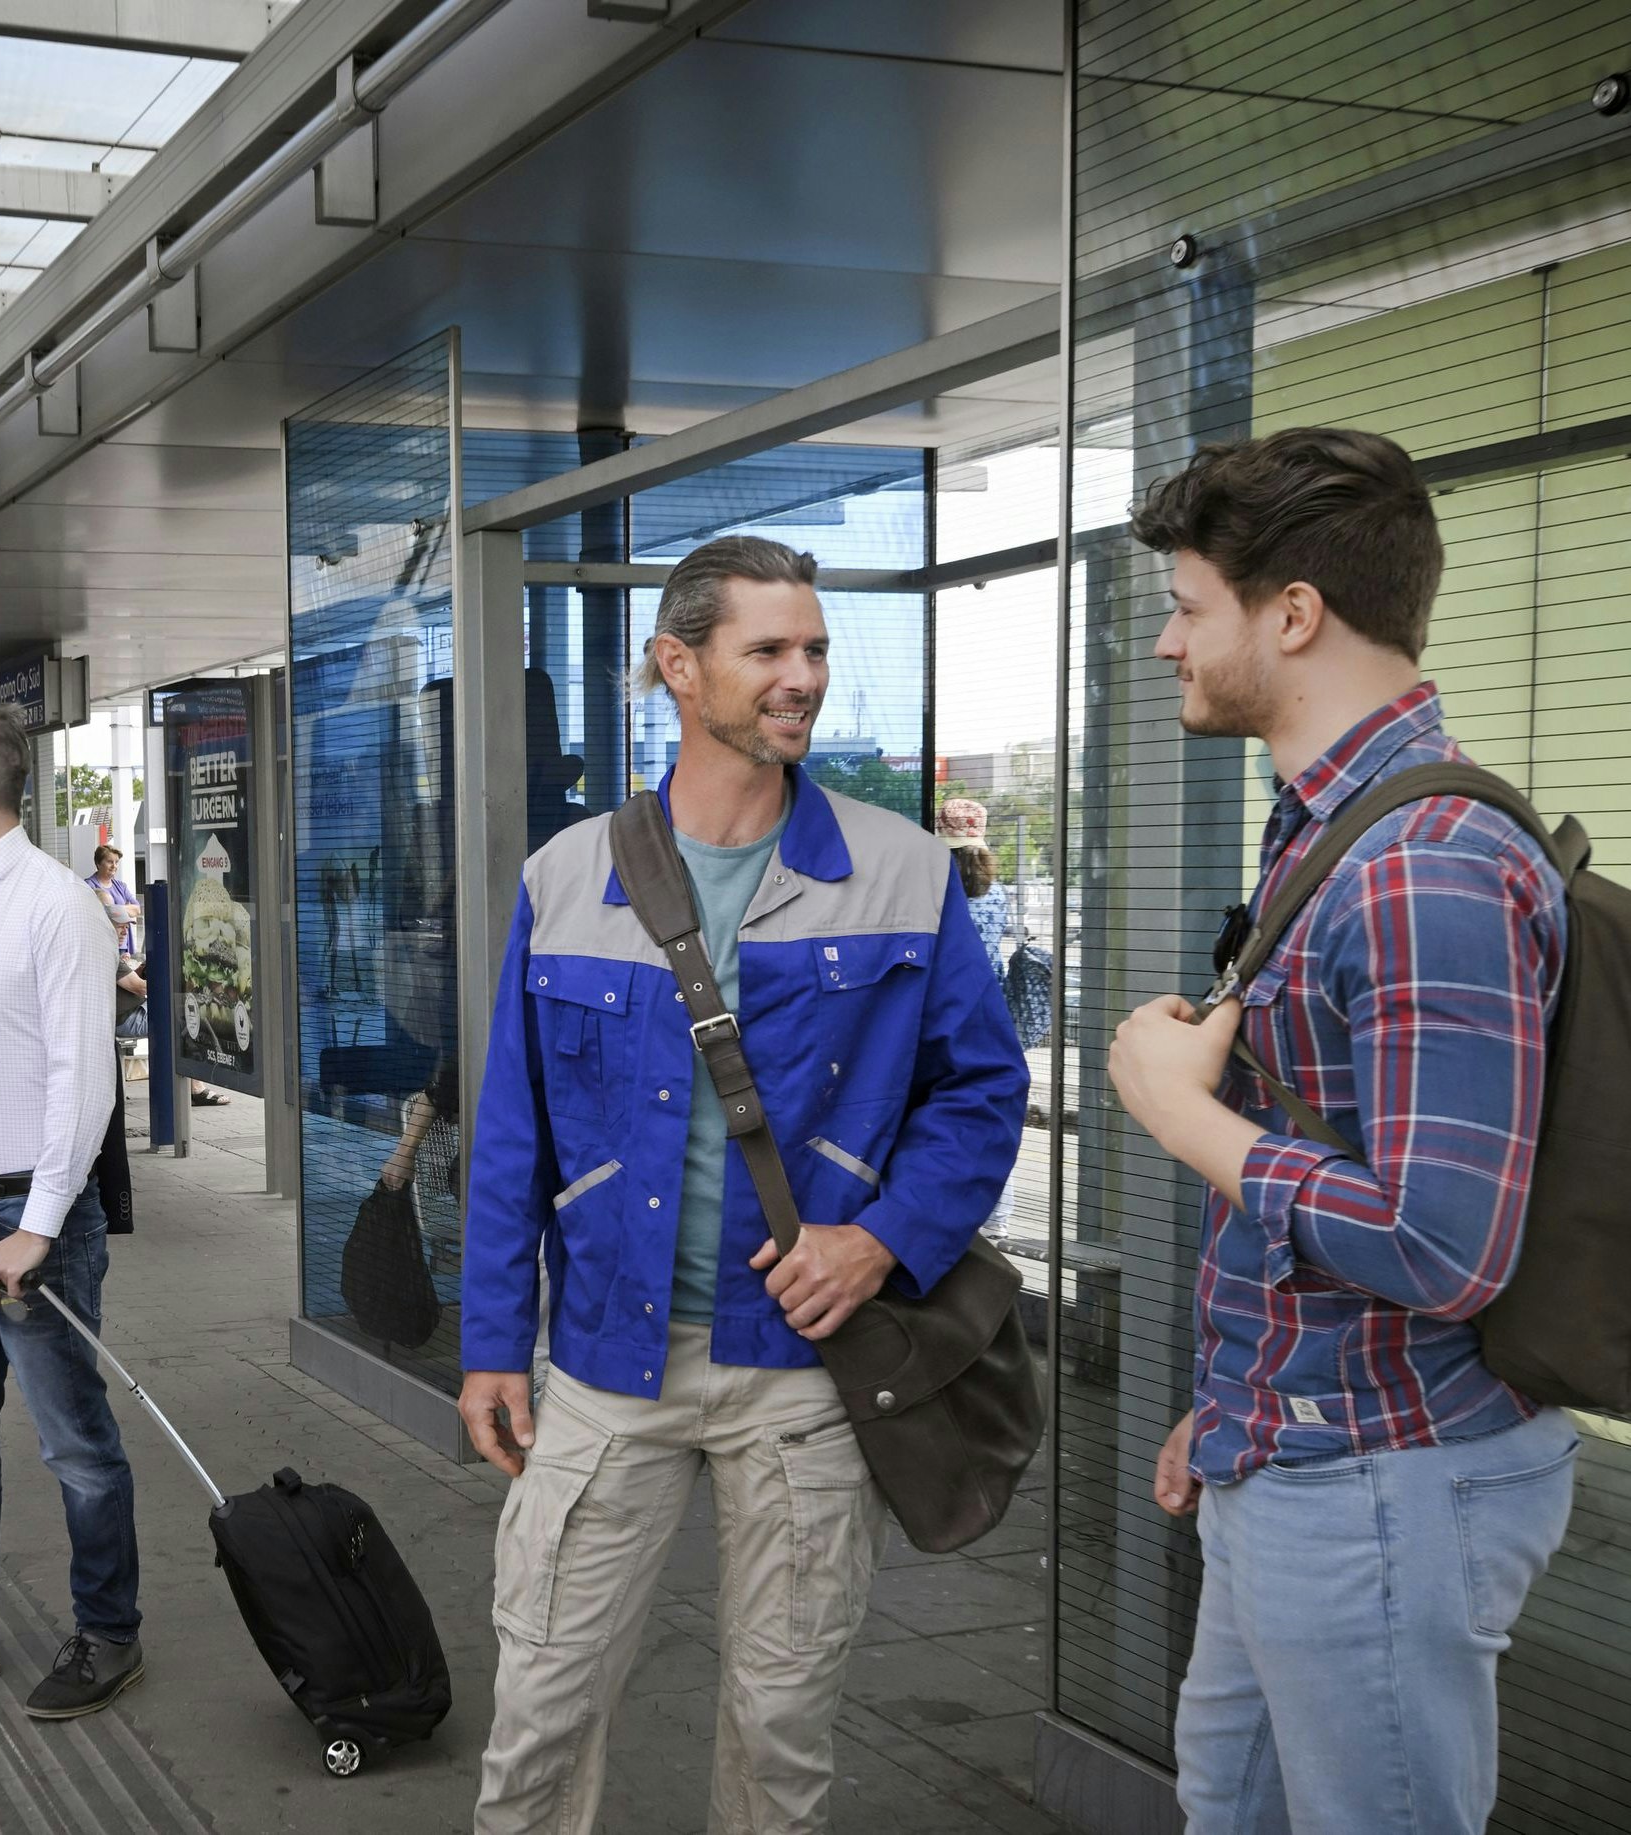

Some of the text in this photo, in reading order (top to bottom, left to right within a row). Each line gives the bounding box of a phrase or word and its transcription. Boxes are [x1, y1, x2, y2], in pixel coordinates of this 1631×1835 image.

[16, 671, 28, 698] City
[29, 663, 41, 691] Süd
[190, 751, 238, 786] BETTER
[191, 794, 238, 822] BURGERN.
[202, 856, 224, 868] EINGANG
